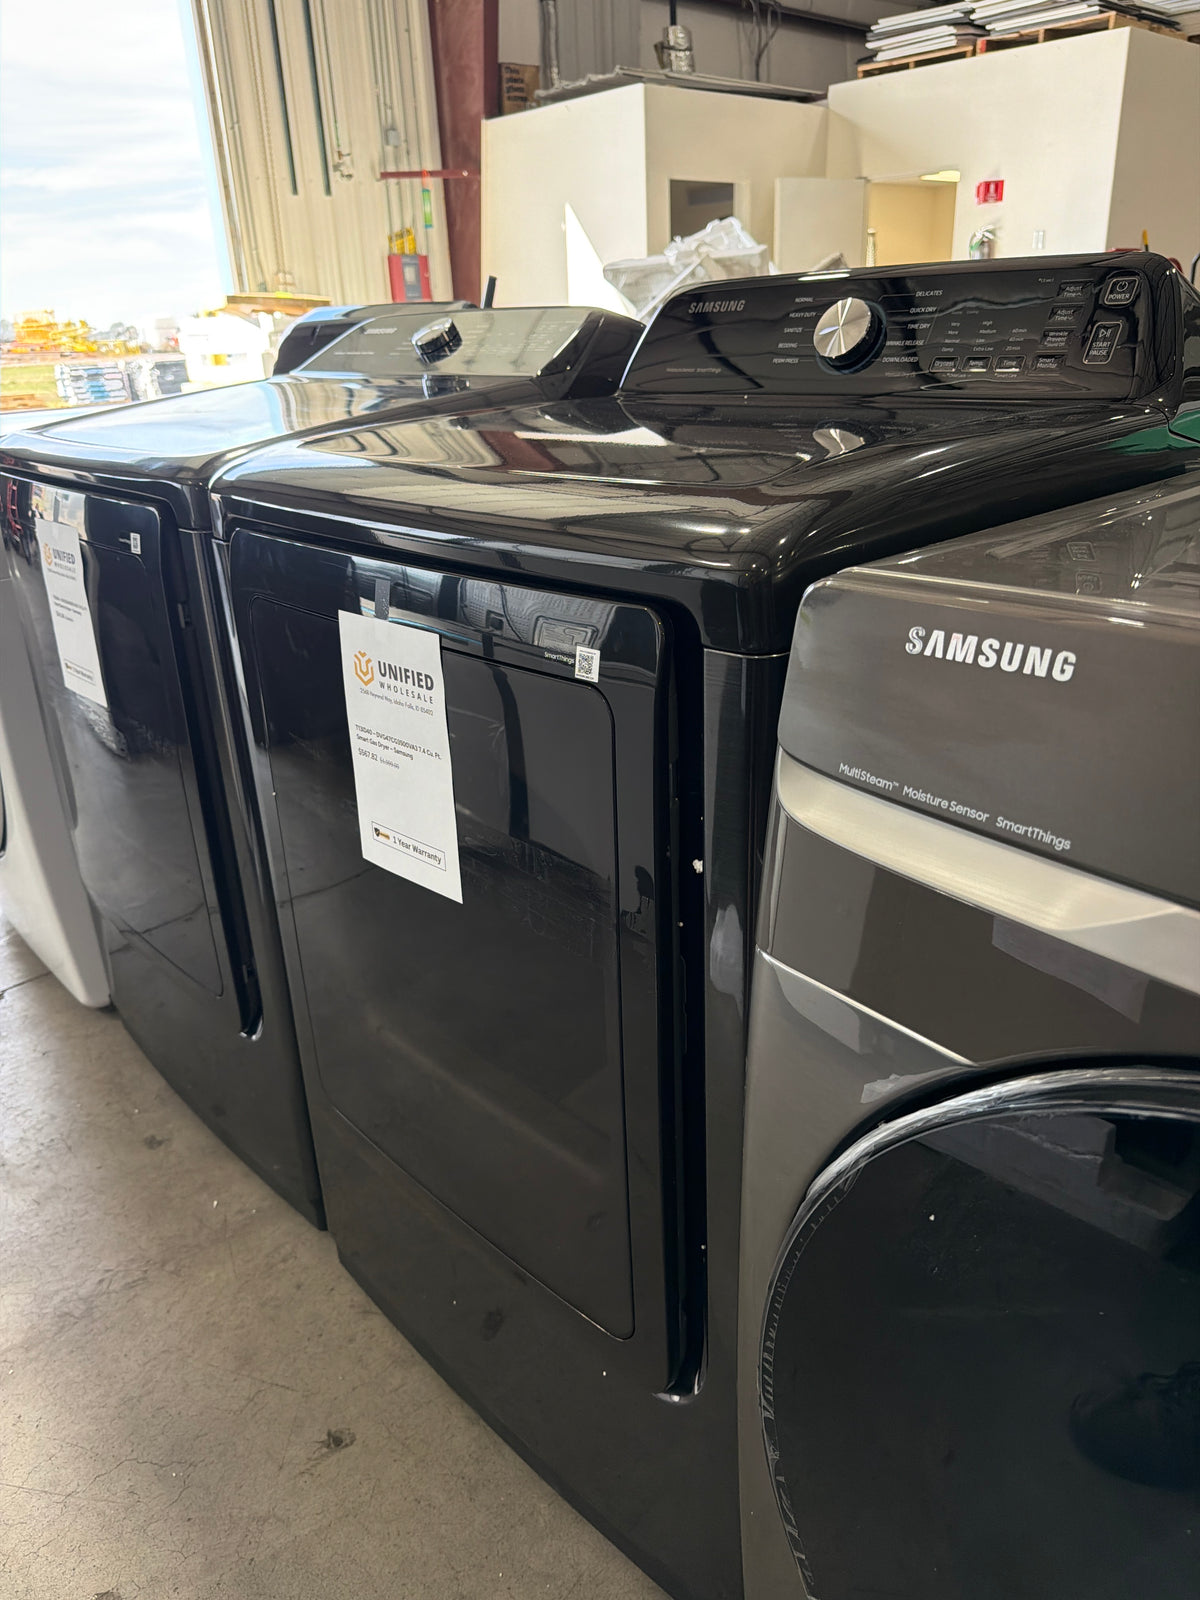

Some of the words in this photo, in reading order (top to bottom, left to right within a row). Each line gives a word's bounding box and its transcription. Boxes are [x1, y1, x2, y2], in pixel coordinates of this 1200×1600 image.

[688, 300, 746, 314] SAMSUNG
[544, 651, 575, 665] SmartThings
[905, 626, 1077, 682] SAMSUNG
[377, 660, 434, 691] UNIFIED
[379, 681, 433, 704] WHOLESALE
[378, 740, 390, 751] Dryer
[902, 785, 949, 810] Moisture
[949, 800, 990, 823] Sensor
[996, 816, 1071, 851] SmartThings
[397, 838, 411, 849] Year
[412, 844, 442, 865] Warranty
